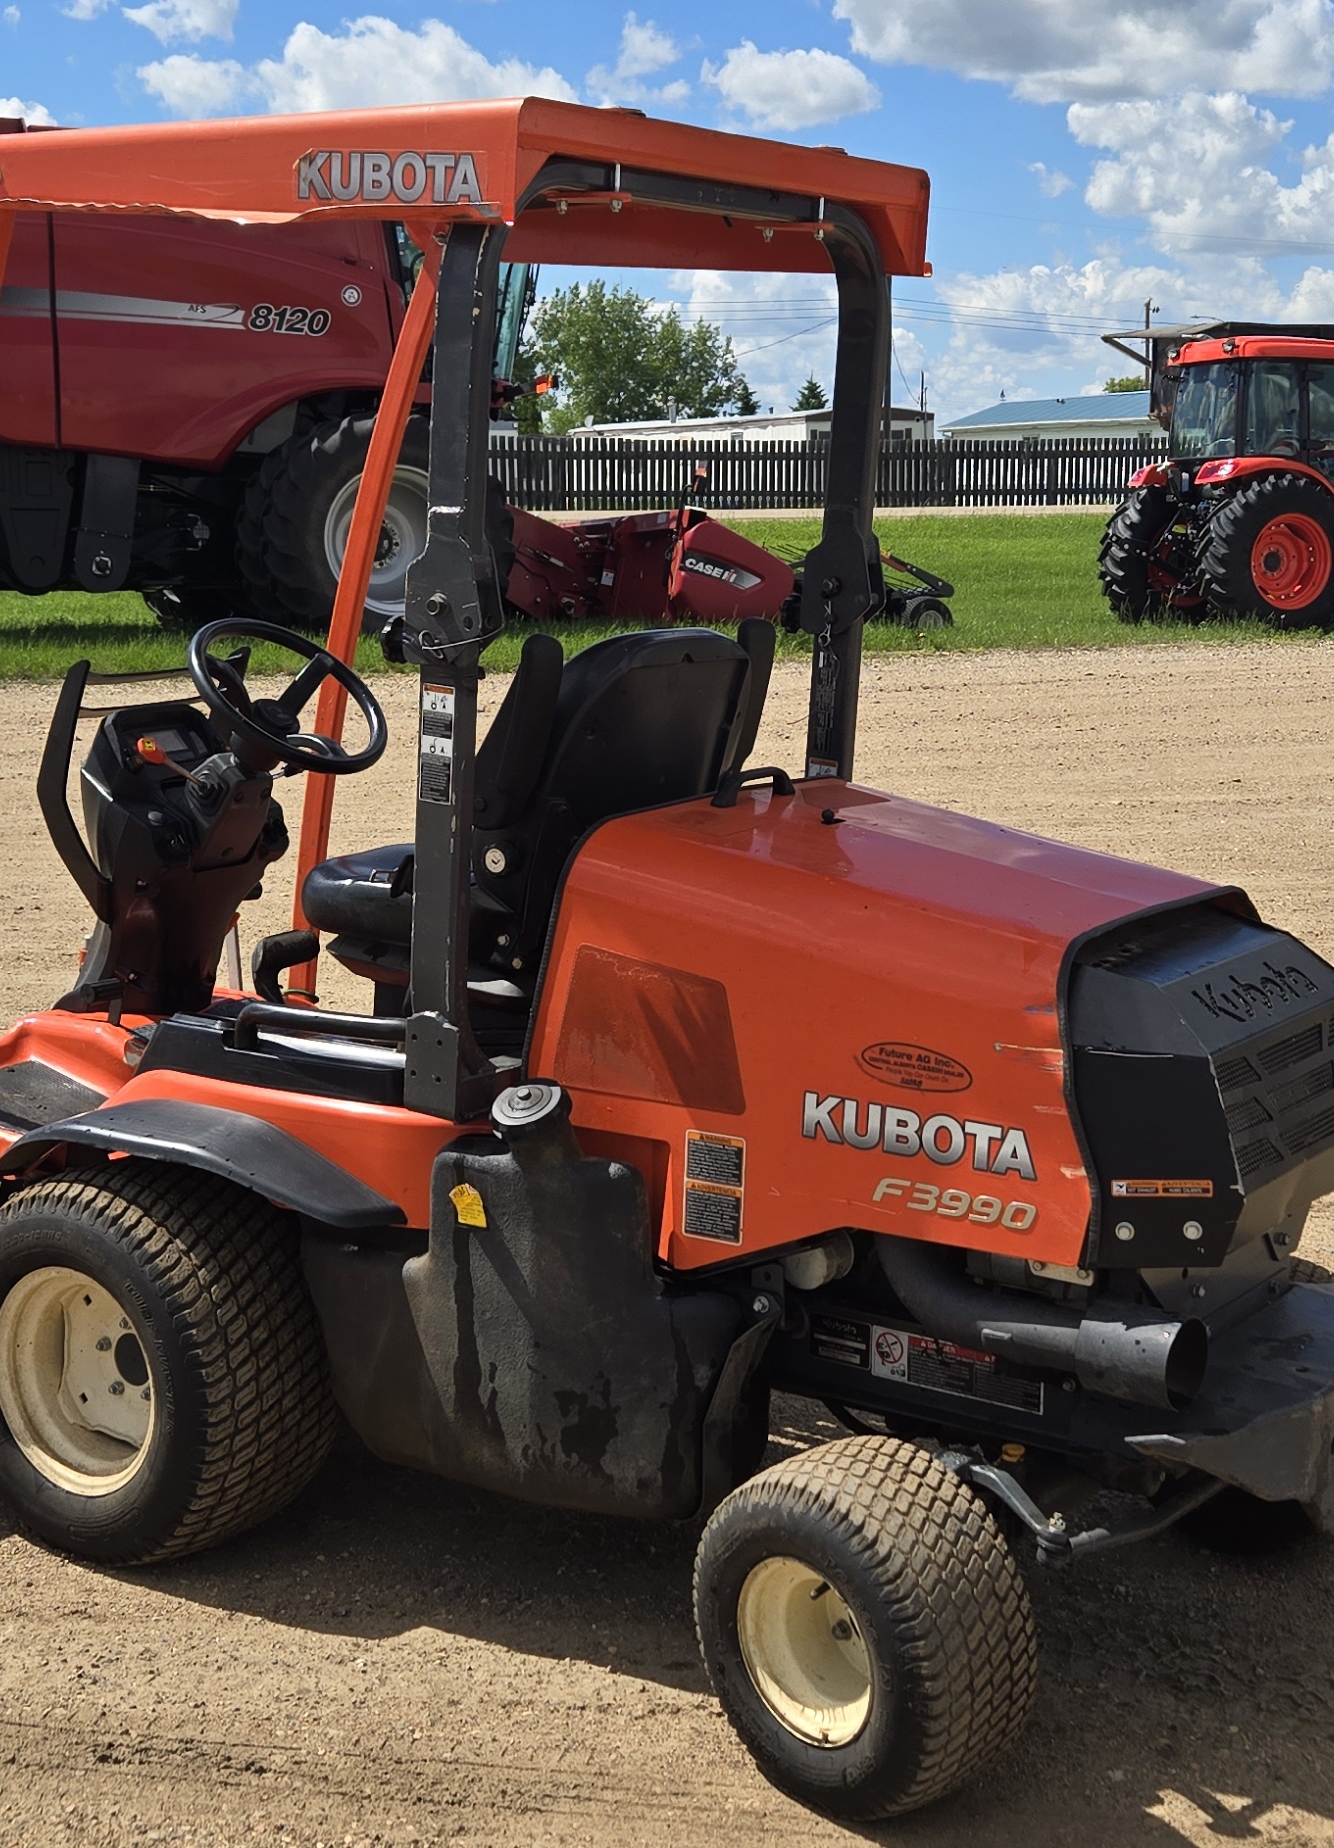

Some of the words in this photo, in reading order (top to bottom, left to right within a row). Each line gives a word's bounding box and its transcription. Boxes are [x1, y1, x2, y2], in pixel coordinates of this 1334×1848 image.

[297, 150, 482, 203] KUBOTA
[247, 303, 332, 337] 8120
[685, 558, 723, 578] CASE
[1191, 961, 1319, 1023] Kubota
[878, 1047, 913, 1061] Future
[801, 1090, 1037, 1181] KUBOTA
[872, 1177, 1037, 1230] F3990
